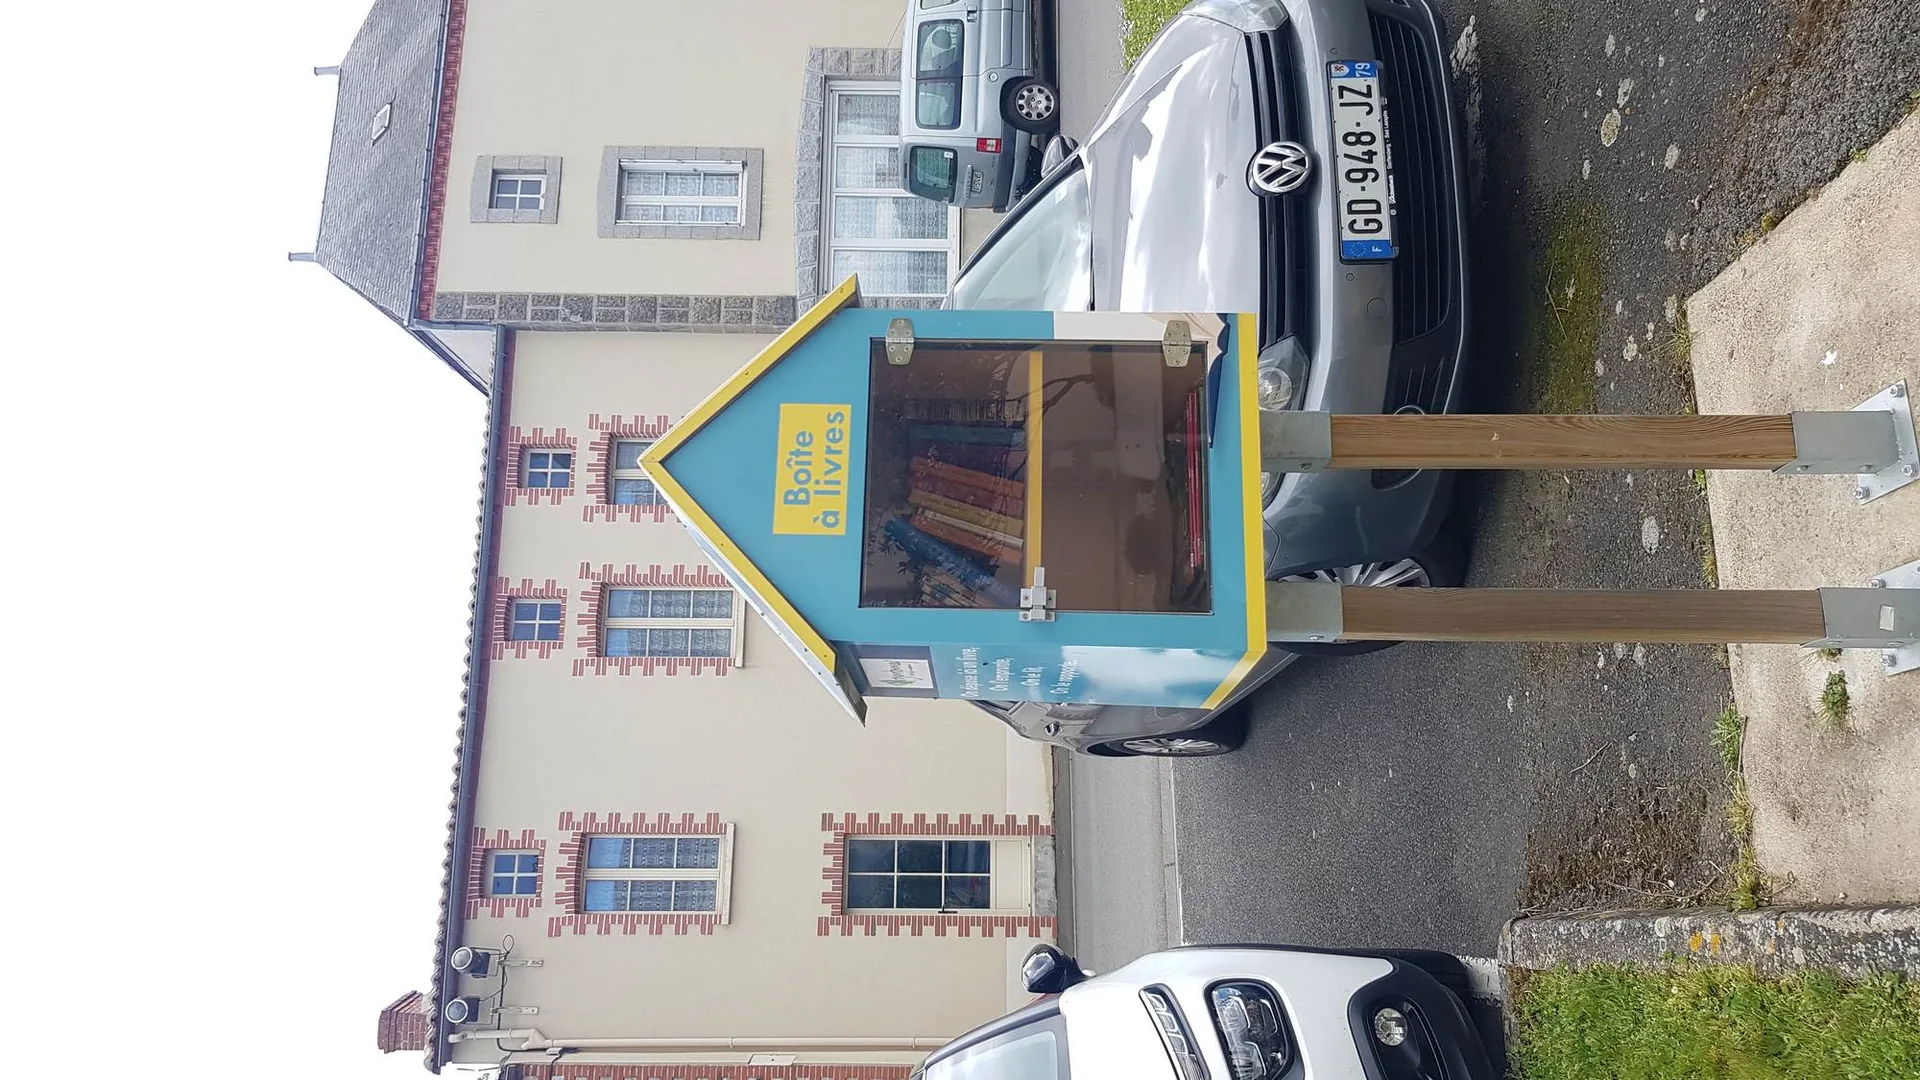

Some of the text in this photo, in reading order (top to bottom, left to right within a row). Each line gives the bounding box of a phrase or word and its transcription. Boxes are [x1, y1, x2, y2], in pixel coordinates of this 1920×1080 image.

[1354, 62, 1371, 78] 79
[783, 430, 814, 506] Boîte
[812, 411, 844, 528] à livres
[989, 684, 1009, 692] On
